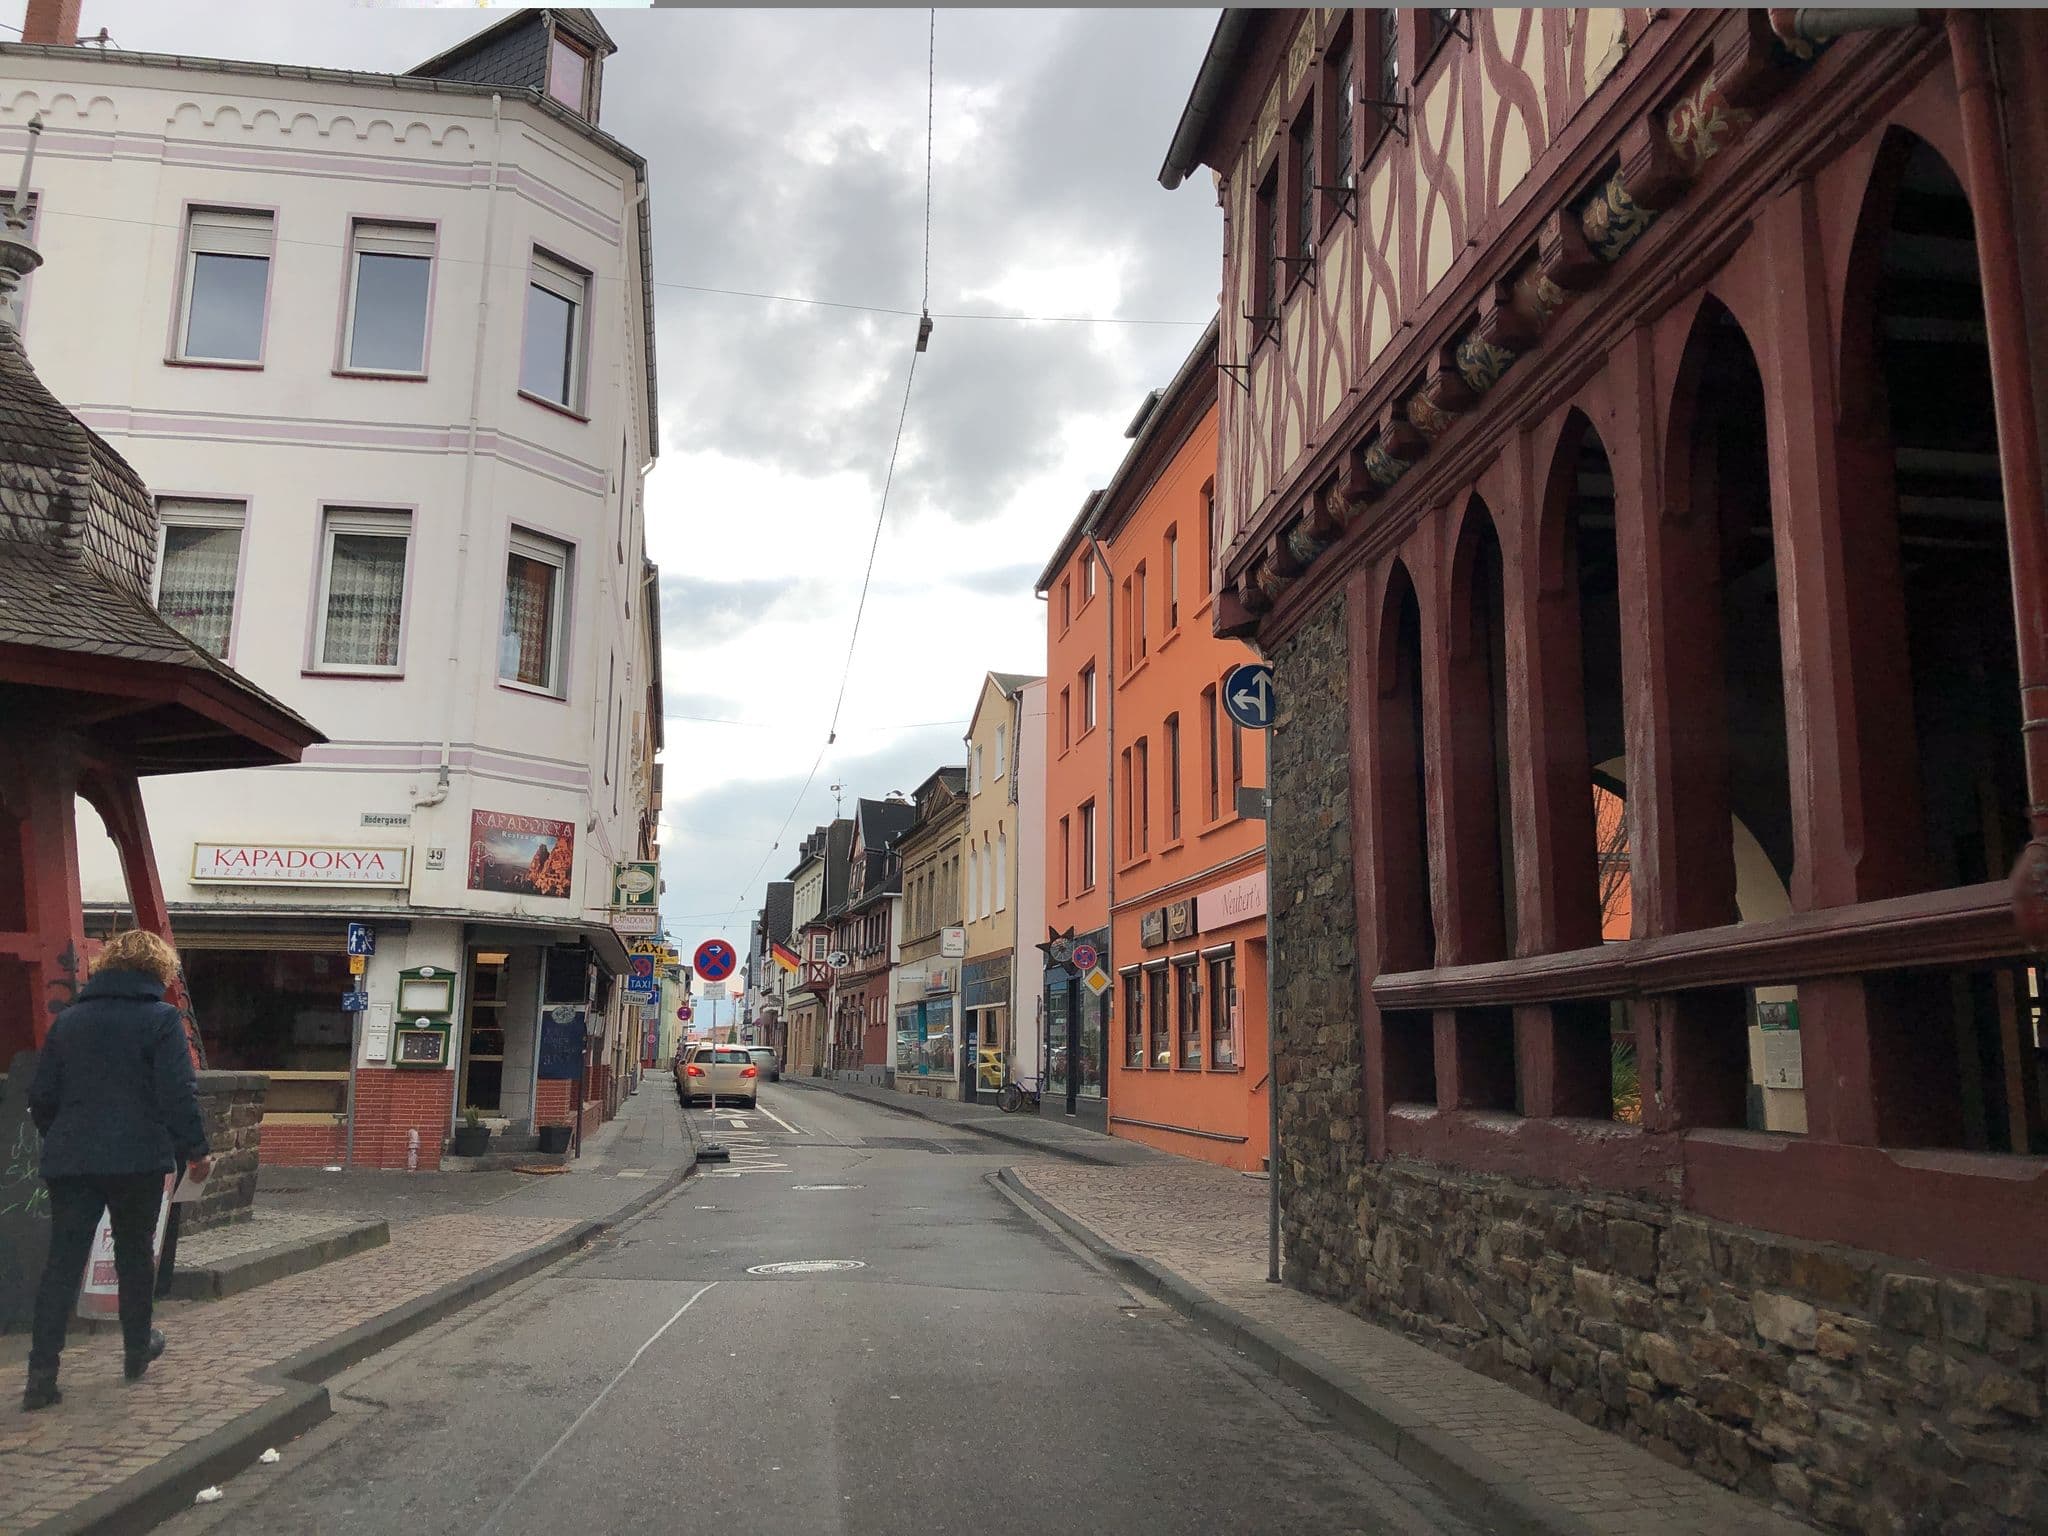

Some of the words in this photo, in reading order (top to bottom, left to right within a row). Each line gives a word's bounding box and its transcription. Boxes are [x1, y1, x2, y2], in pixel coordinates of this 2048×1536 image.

[215, 849, 385, 871] KAPADOKYA
[428, 850, 443, 860] 49
[635, 944, 664, 954] TAXI
[631, 980, 651, 989] TAXI
